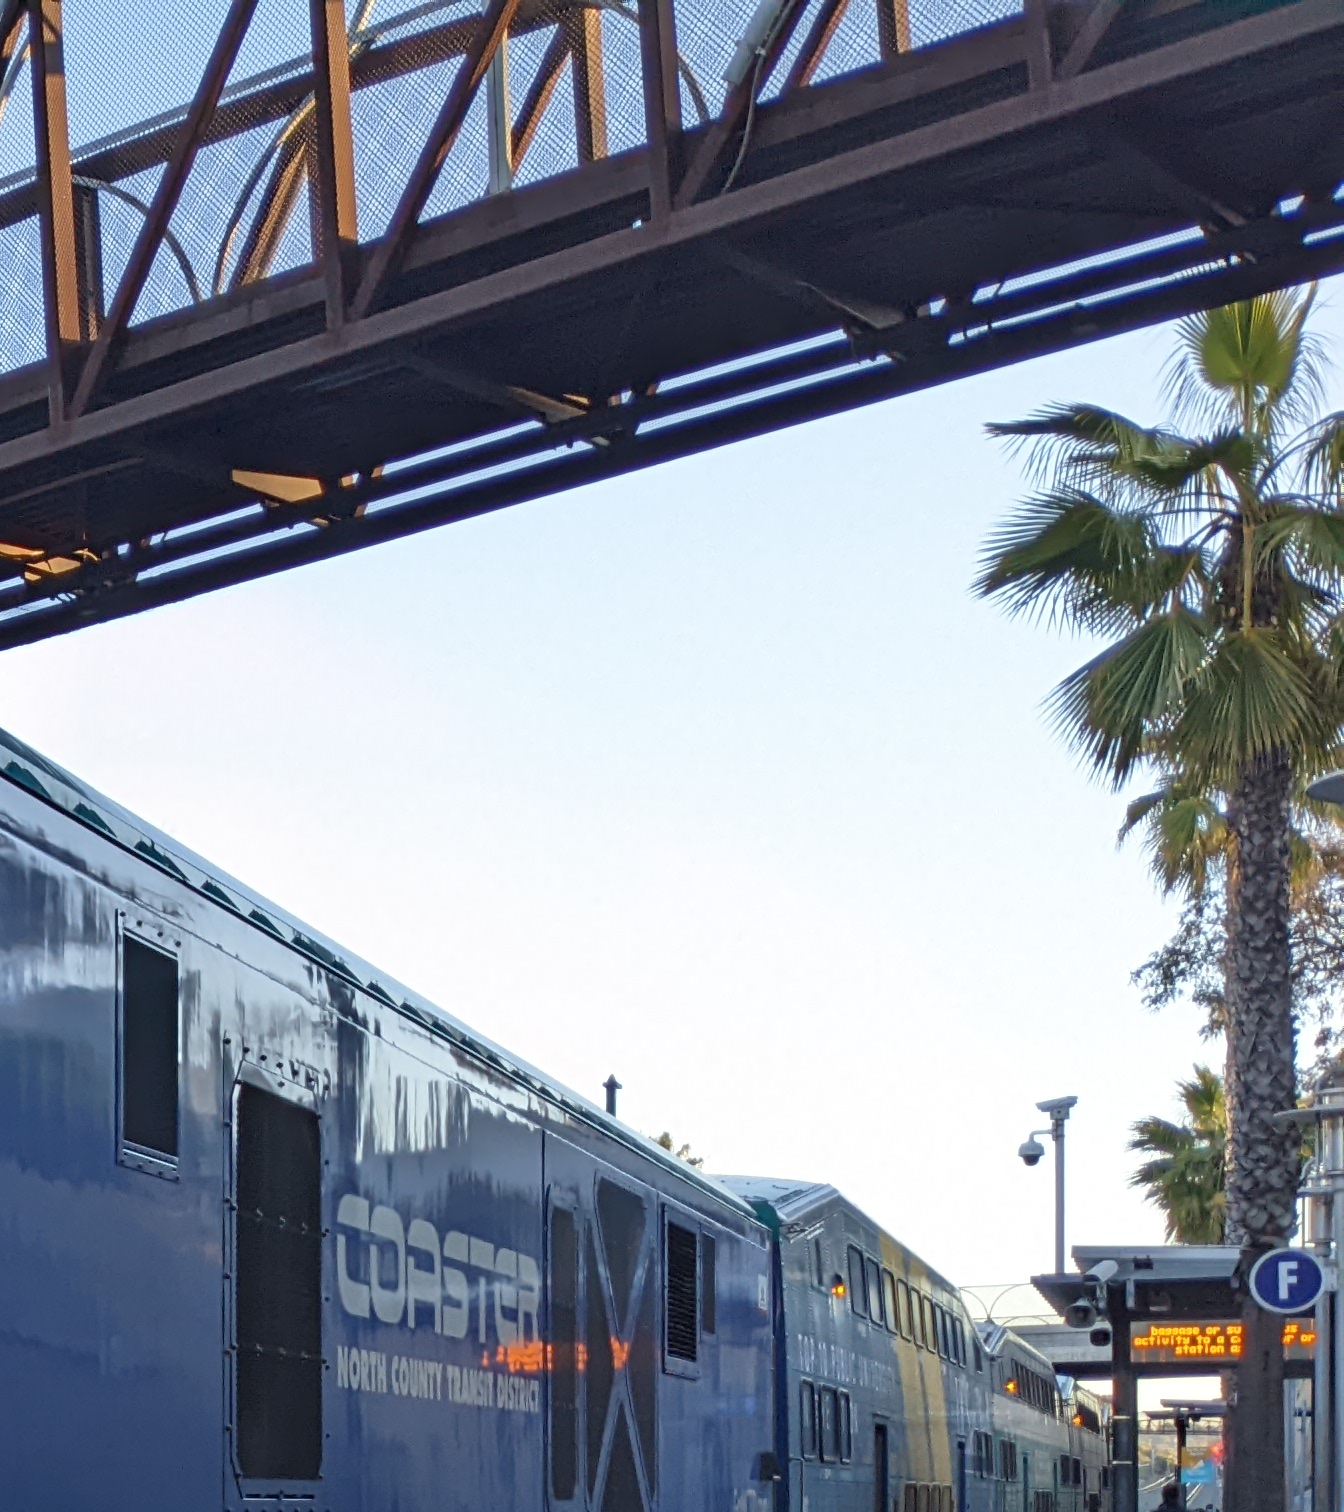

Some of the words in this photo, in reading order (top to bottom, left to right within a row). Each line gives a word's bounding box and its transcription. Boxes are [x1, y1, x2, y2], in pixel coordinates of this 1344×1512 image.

[336, 1193, 540, 1349] COASTER
[1278, 1260, 1298, 1300] F
[1133, 1335, 1190, 1347] activity
[1196, 1334, 1212, 1345] to
[1216, 1335, 1225, 1345] a
[1299, 1333, 1316, 1344] or
[1205, 1325, 1222, 1336] or
[1174, 1344, 1225, 1356] station
[336, 1345, 388, 1394] NORTH
[391, 1355, 443, 1401] COUNTY
[446, 1364, 494, 1408] TRANSIT
[497, 1372, 540, 1413] DISTRICT
